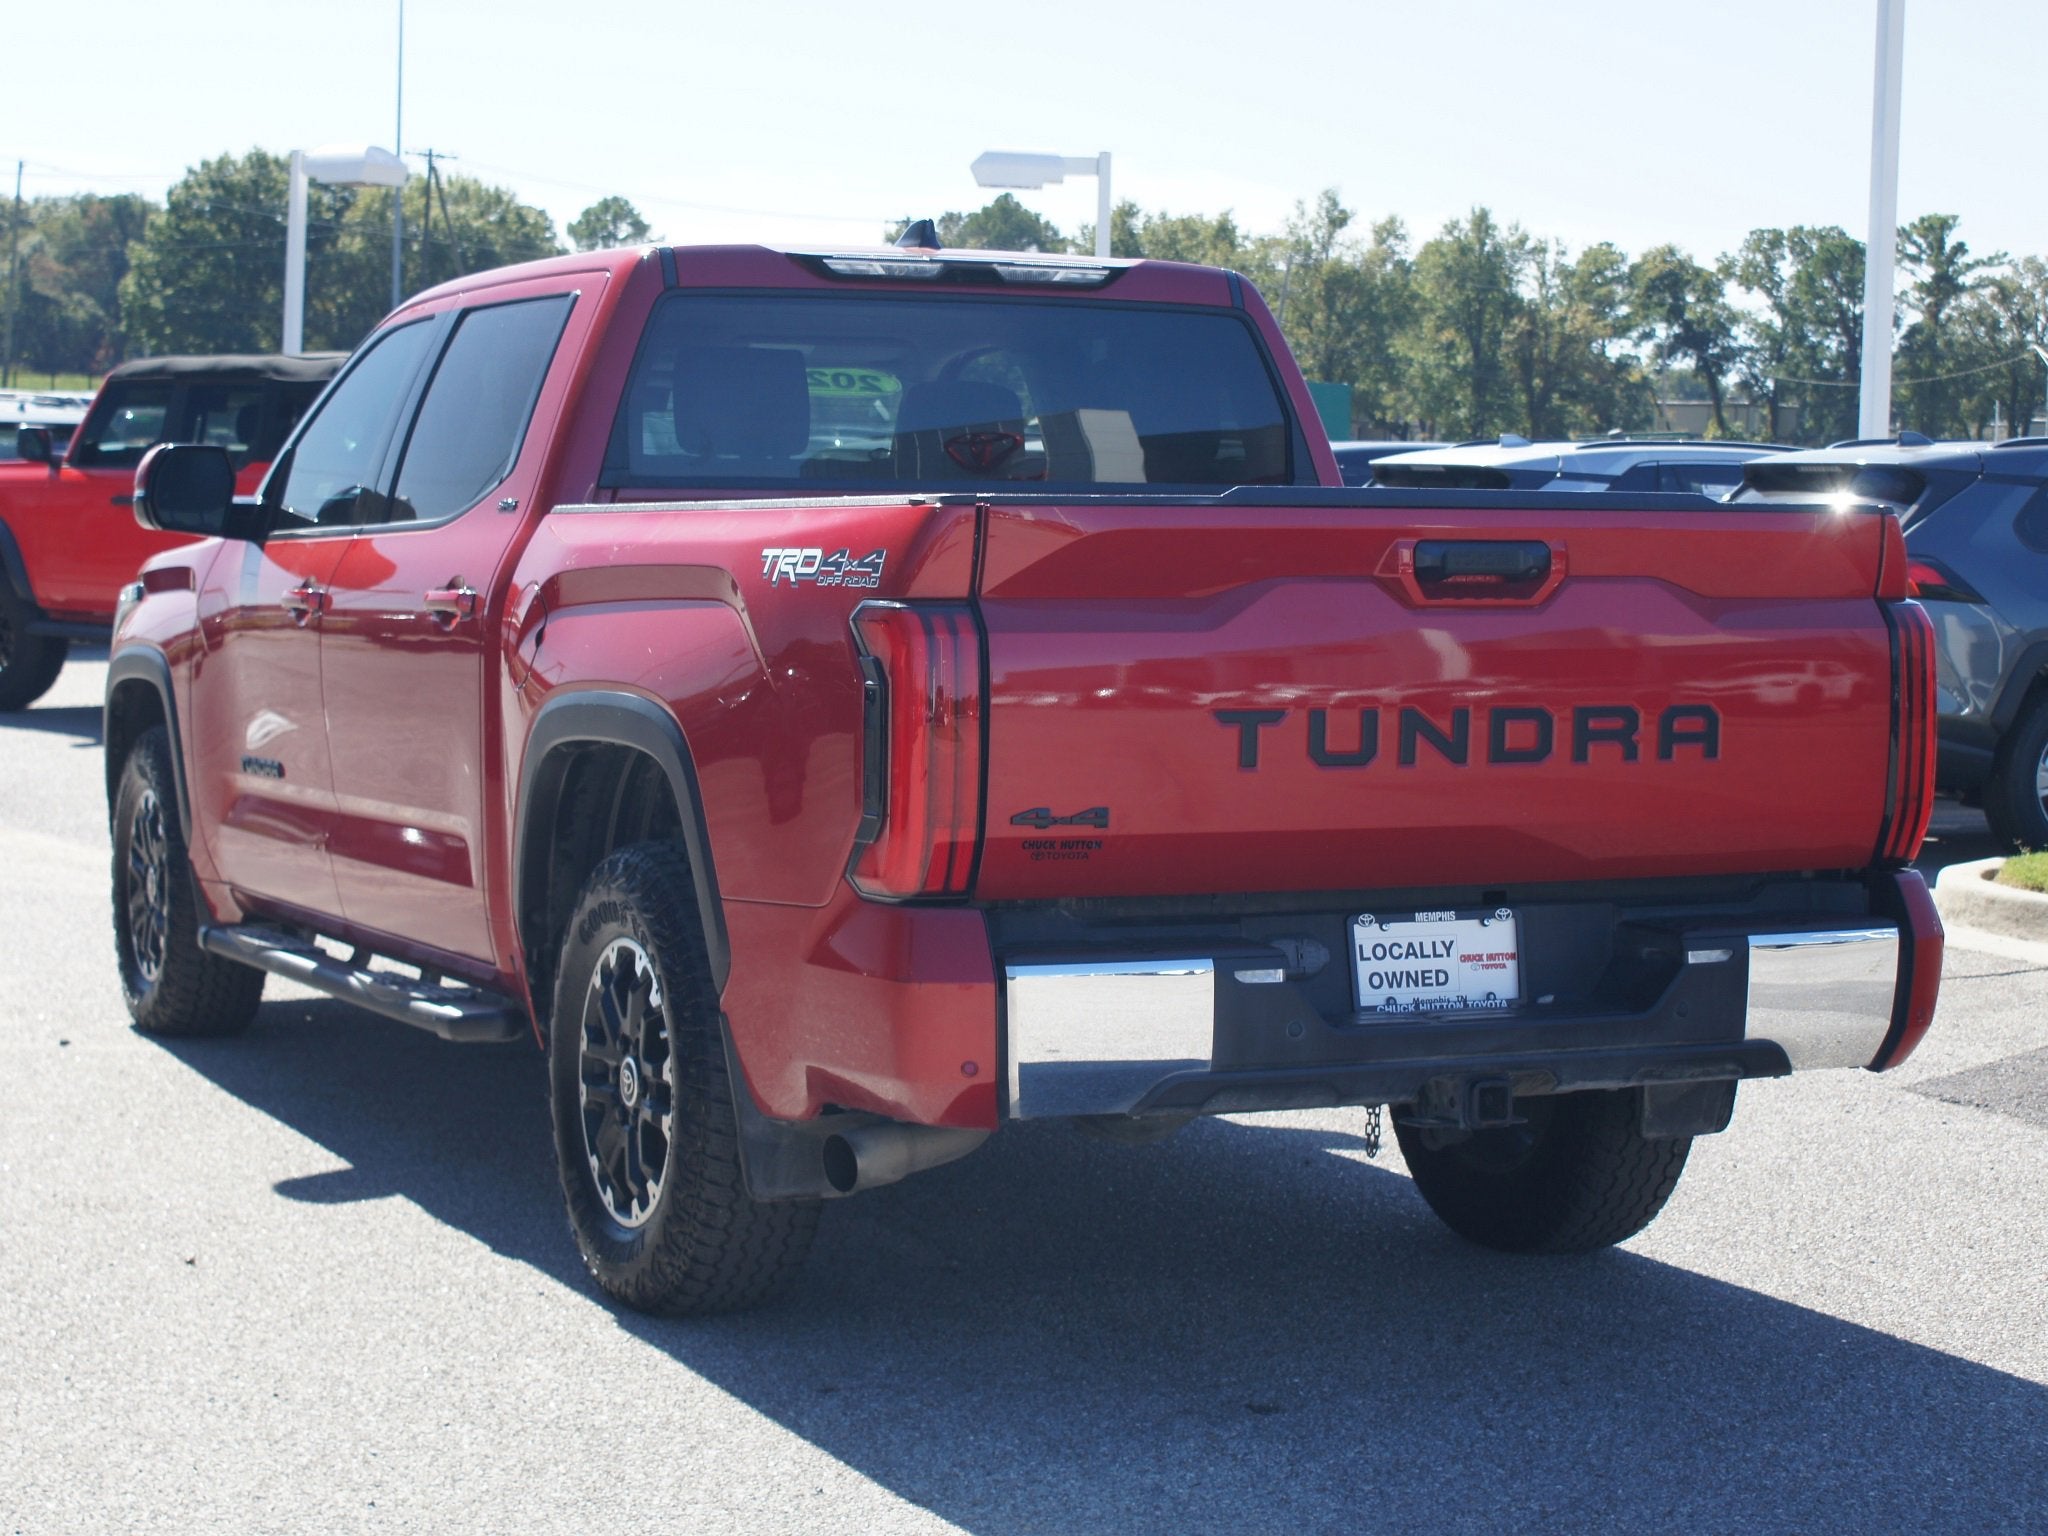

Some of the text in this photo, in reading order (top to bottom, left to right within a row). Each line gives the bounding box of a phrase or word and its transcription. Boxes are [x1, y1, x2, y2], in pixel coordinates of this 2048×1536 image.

[761, 548, 823, 588] TRD
[816, 575, 880, 588] OFF ROAD
[1213, 703, 1720, 770] TUNDRA
[1022, 840, 1102, 850] CHUCK HUTTON
[1047, 851, 1089, 860] TOYOTA
[1415, 911, 1456, 922] MEMPHIS
[1358, 940, 1455, 962] LOCALLY
[1460, 952, 1516, 963] CHUCK HUTTON
[1368, 969, 1450, 990] OWNED
[1376, 999, 1508, 1013] CHUCK HUTTON TOYOTA
